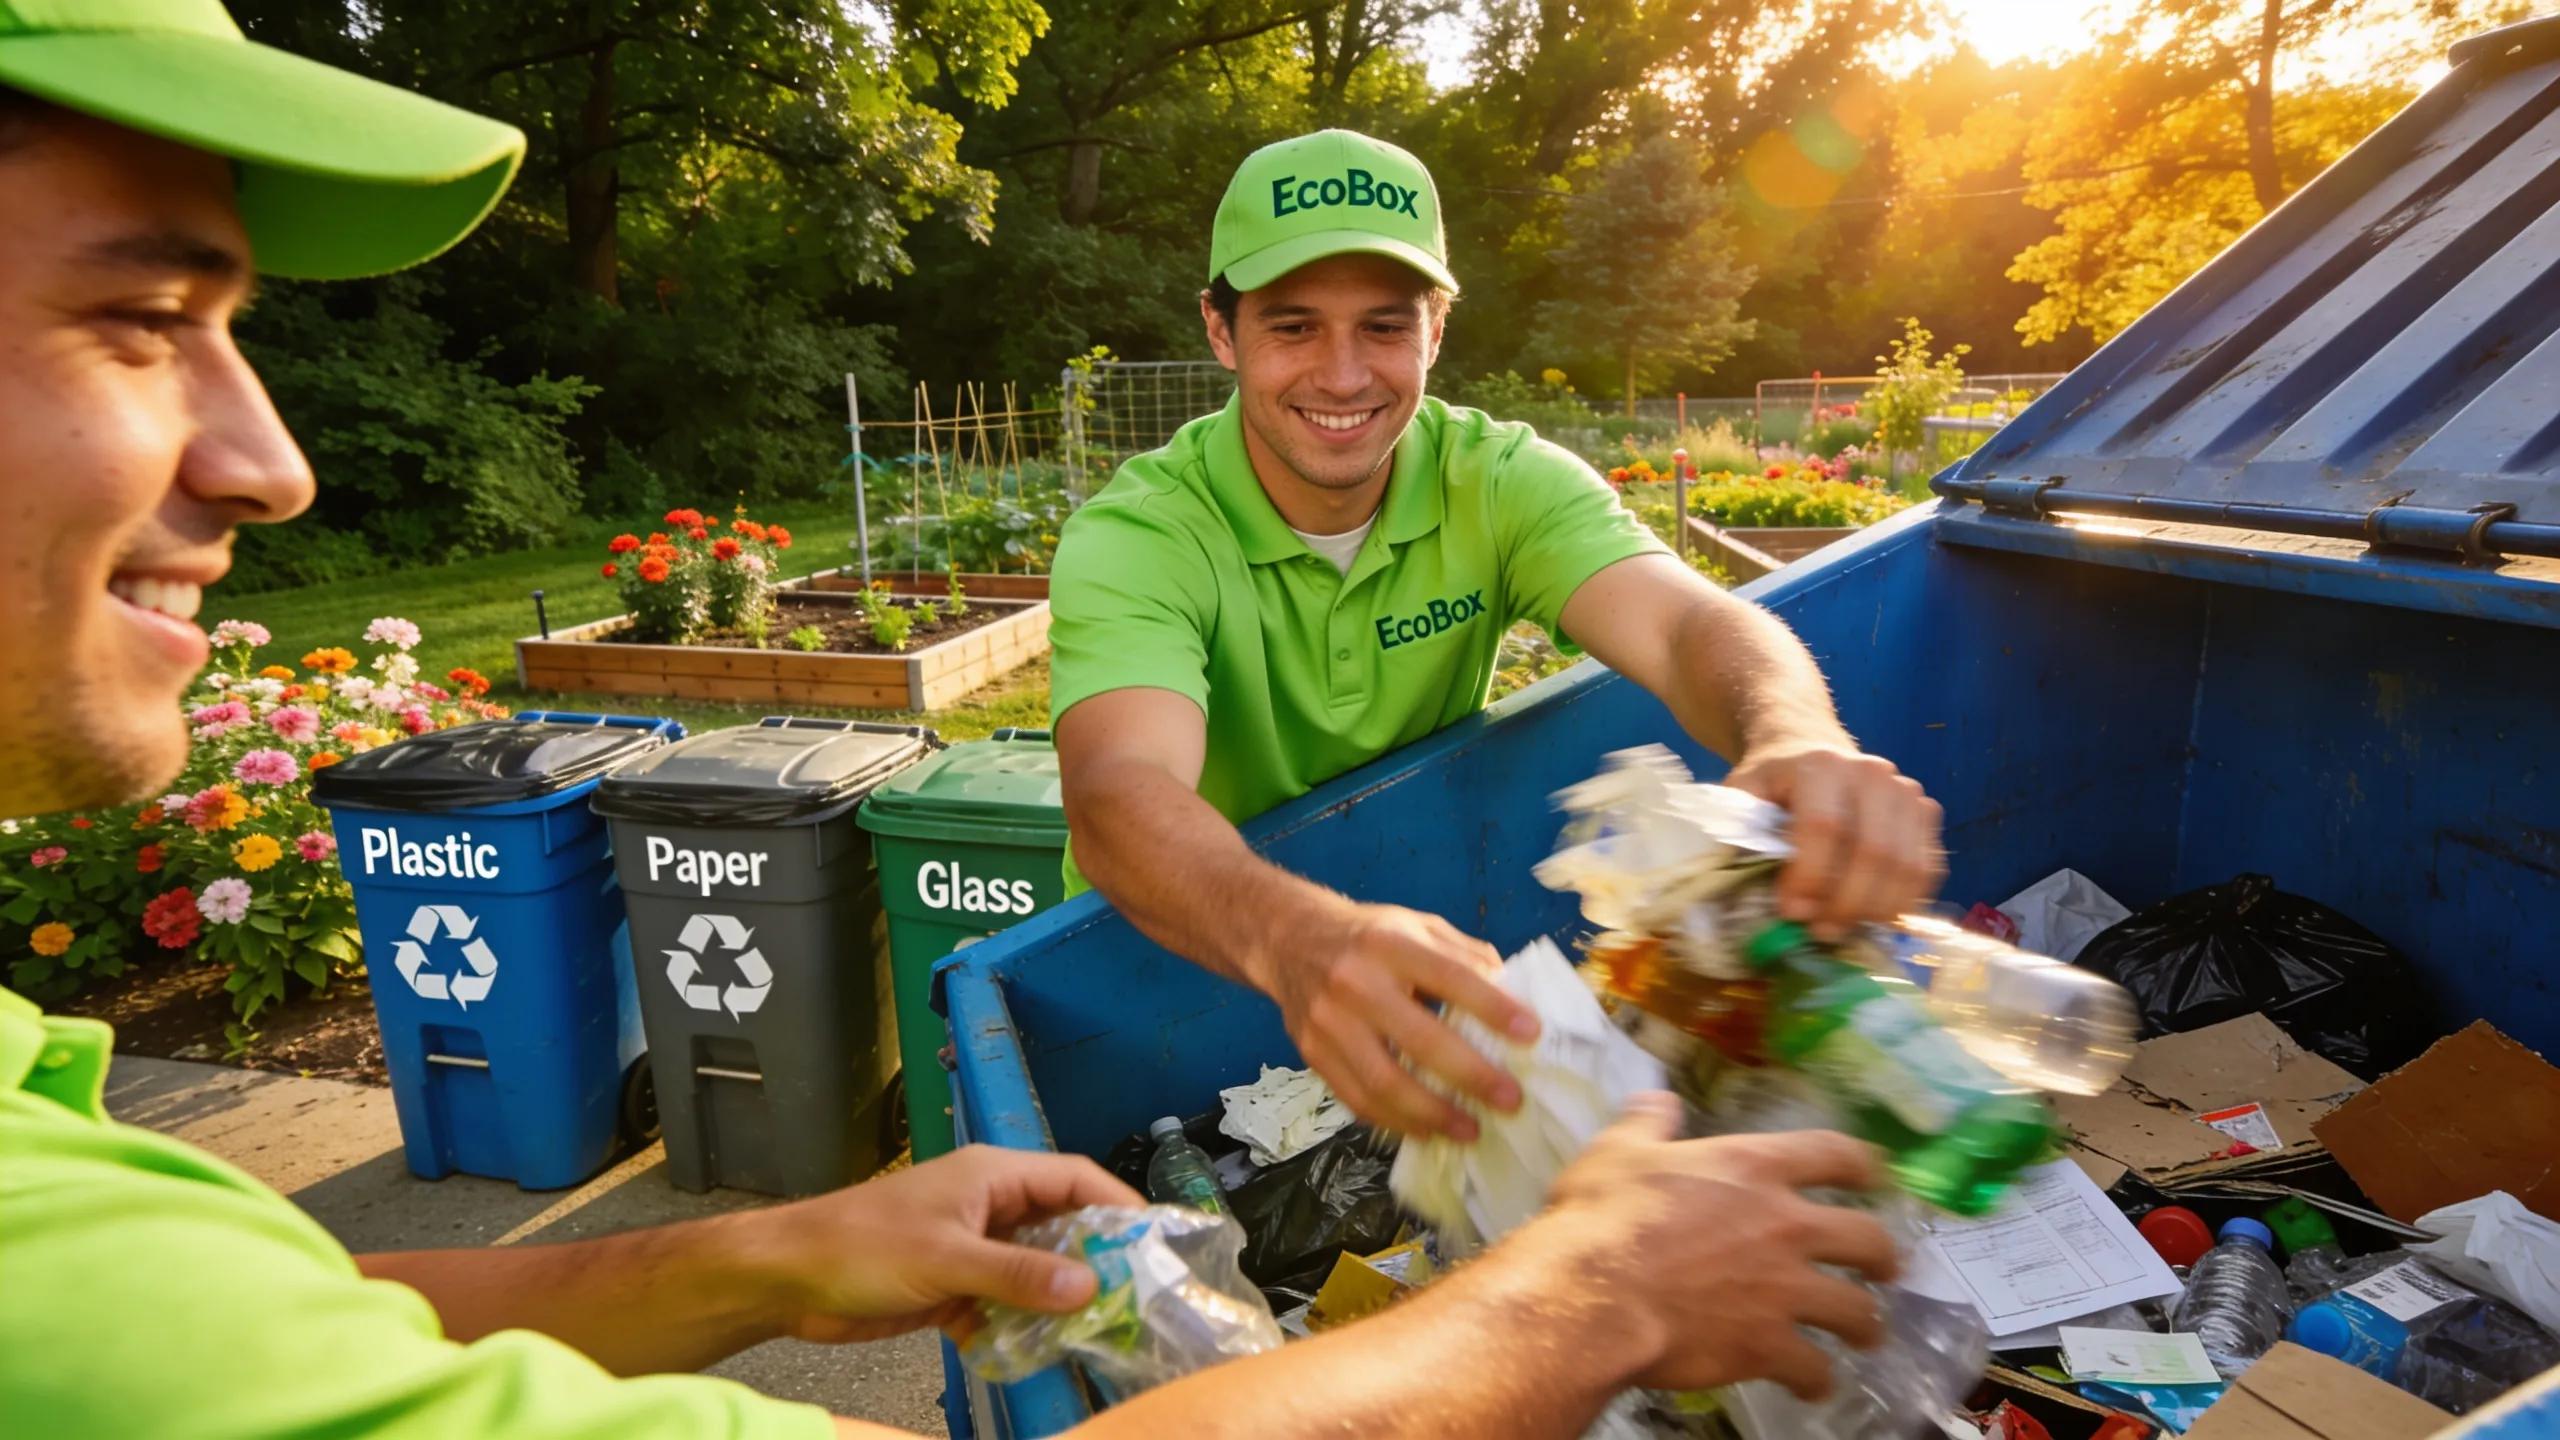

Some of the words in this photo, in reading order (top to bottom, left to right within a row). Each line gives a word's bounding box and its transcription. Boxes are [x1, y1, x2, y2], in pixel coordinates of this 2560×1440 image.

[1272, 168, 1419, 219] EcoBox
[1375, 589, 1487, 650] EcoBox
[361, 827, 499, 879] Plastic
[647, 837, 768, 896] Paper
[917, 860, 1034, 915] Glass
